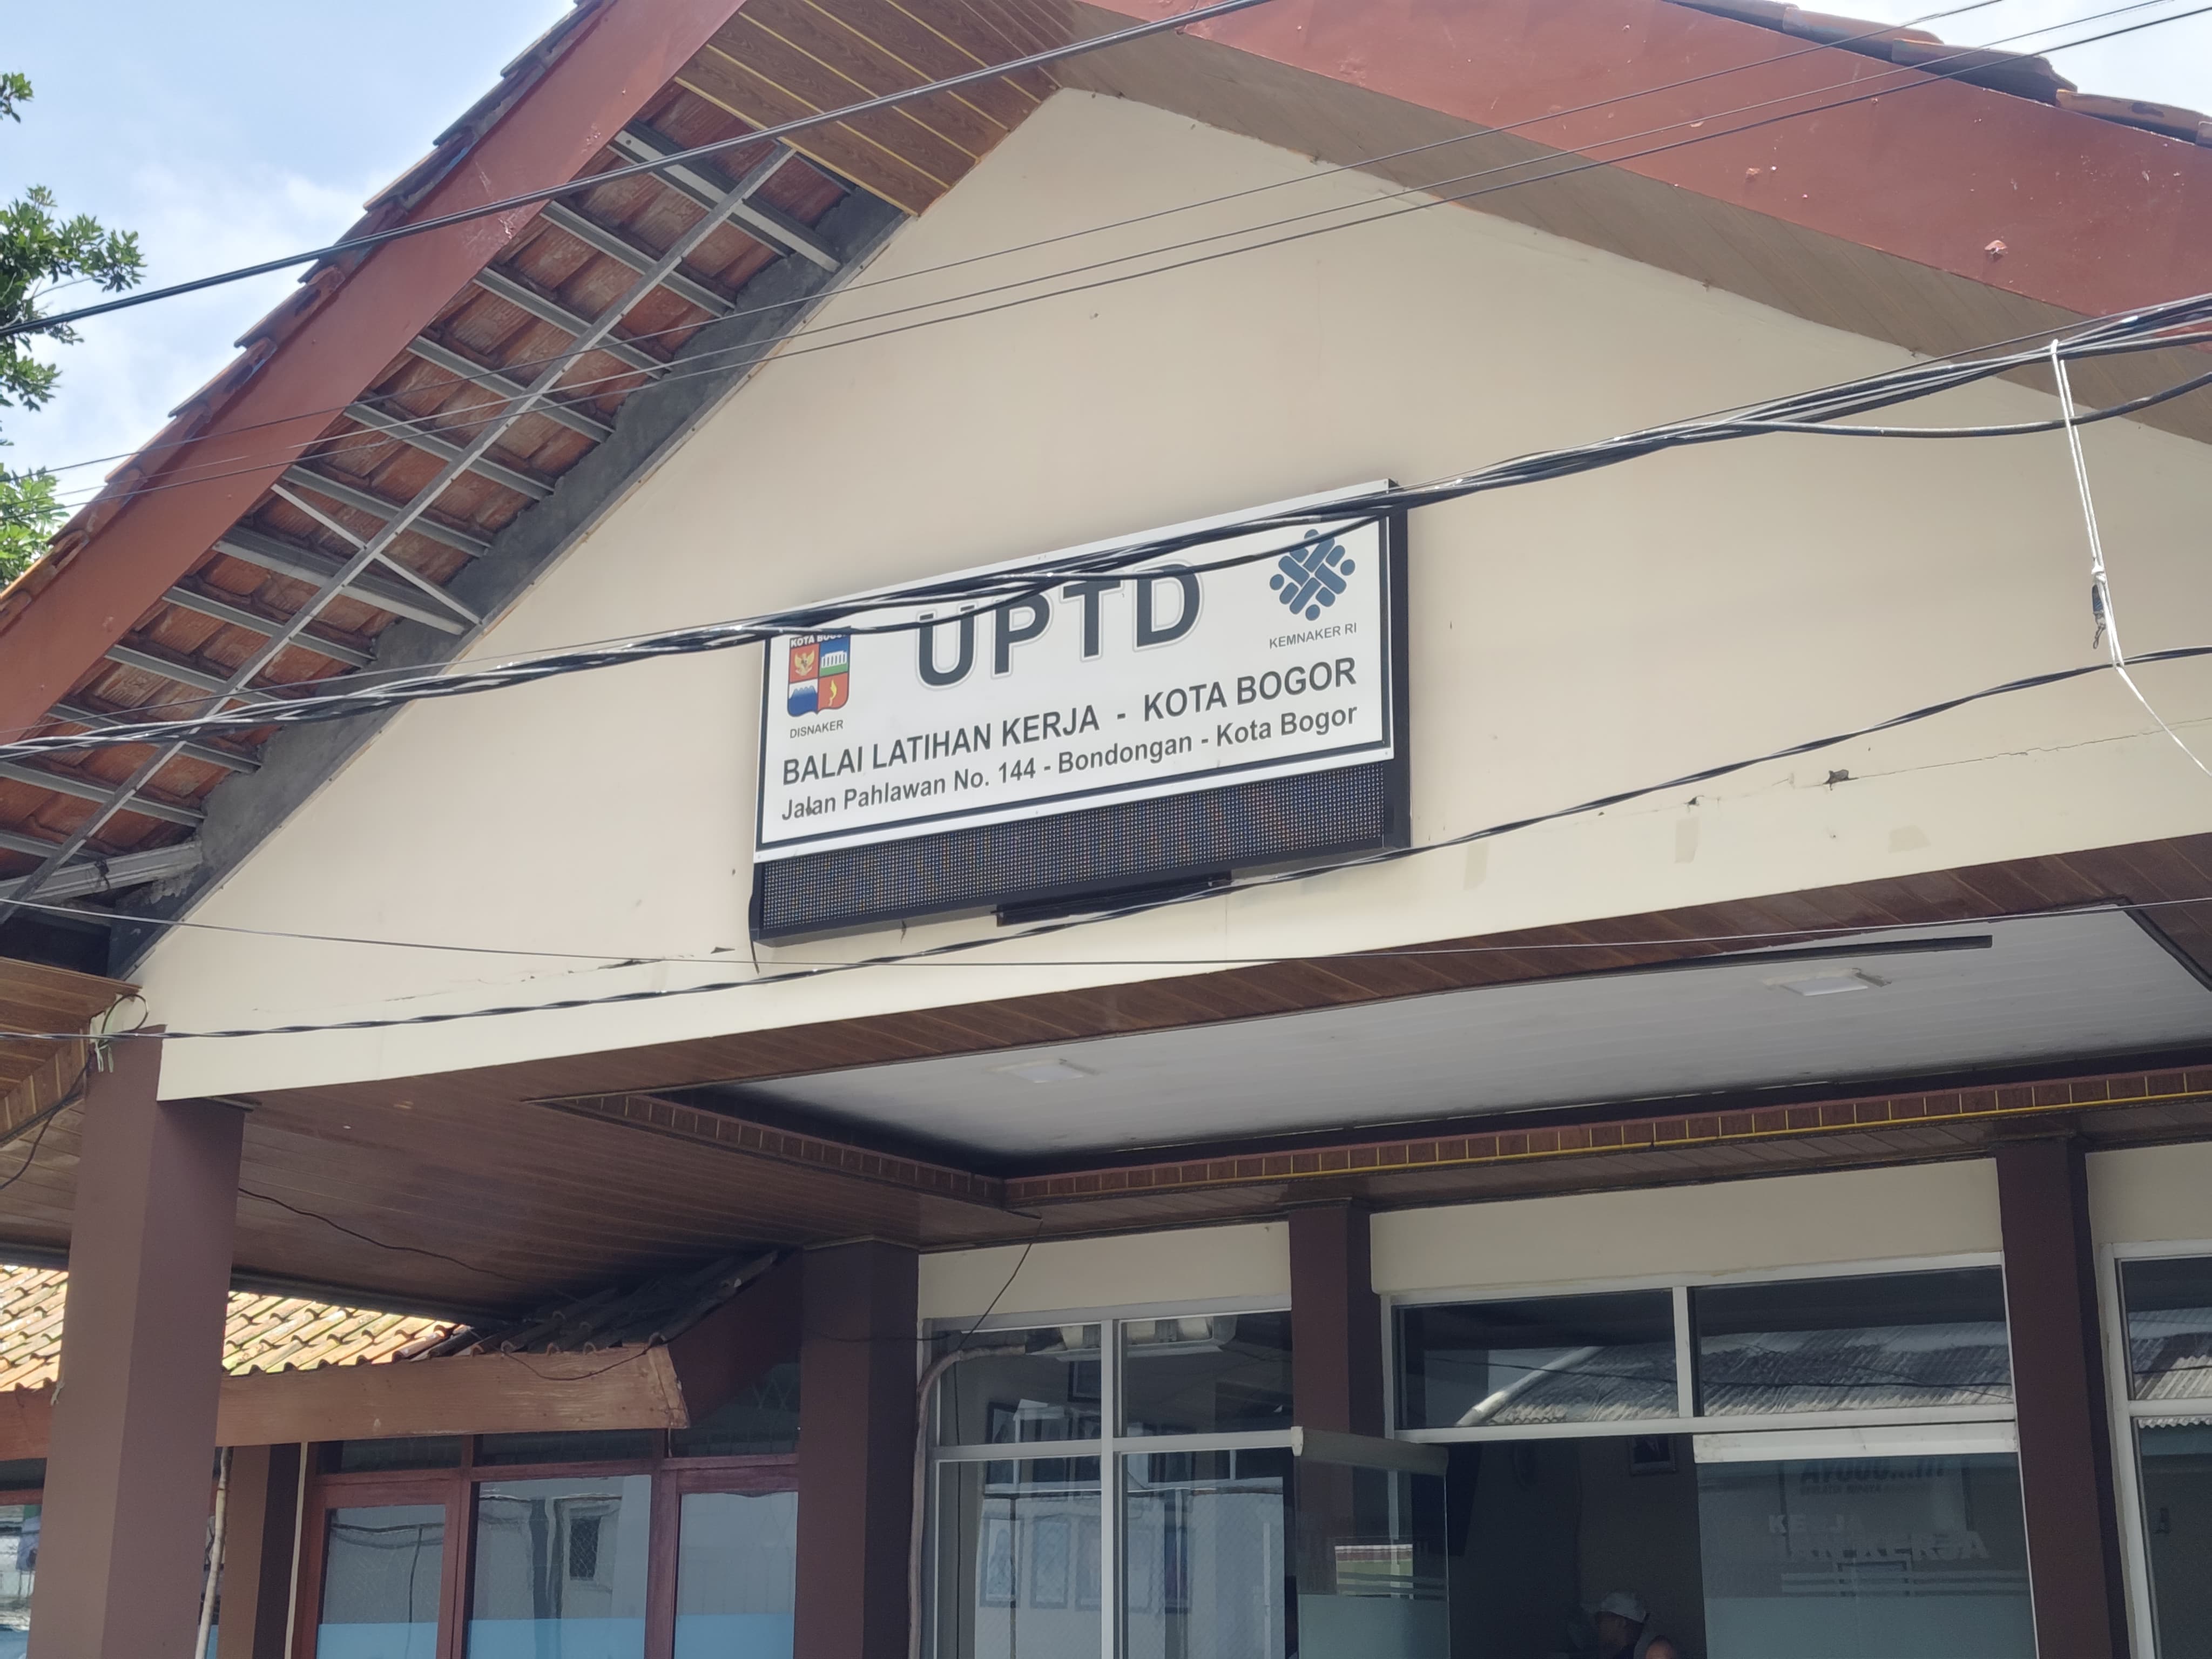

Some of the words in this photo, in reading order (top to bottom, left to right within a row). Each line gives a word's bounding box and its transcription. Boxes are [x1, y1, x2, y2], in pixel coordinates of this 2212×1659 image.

[791, 635, 815, 648] KOTA
[919, 564, 1201, 686] UPTD
[1269, 625, 1341, 649] KEMNAKER
[1345, 622, 1357, 635] RI
[783, 746, 862, 785] BALAI
[873, 723, 991, 770] LATIHAN
[1002, 705, 1100, 747] KERJA
[1144, 682, 1228, 721] KOTA
[1237, 657, 1357, 705] BOGOR
[790, 719, 844, 738] DISNAKER
[781, 796, 836, 821] Jalan
[844, 778, 946, 810] Pahlawan
[954, 768, 989, 791] No.
[999, 757, 1036, 784] 144
[1058, 735, 1192, 774] Bondongan
[1217, 721, 1272, 747] Kota
[1281, 706, 1358, 736] Bogor
